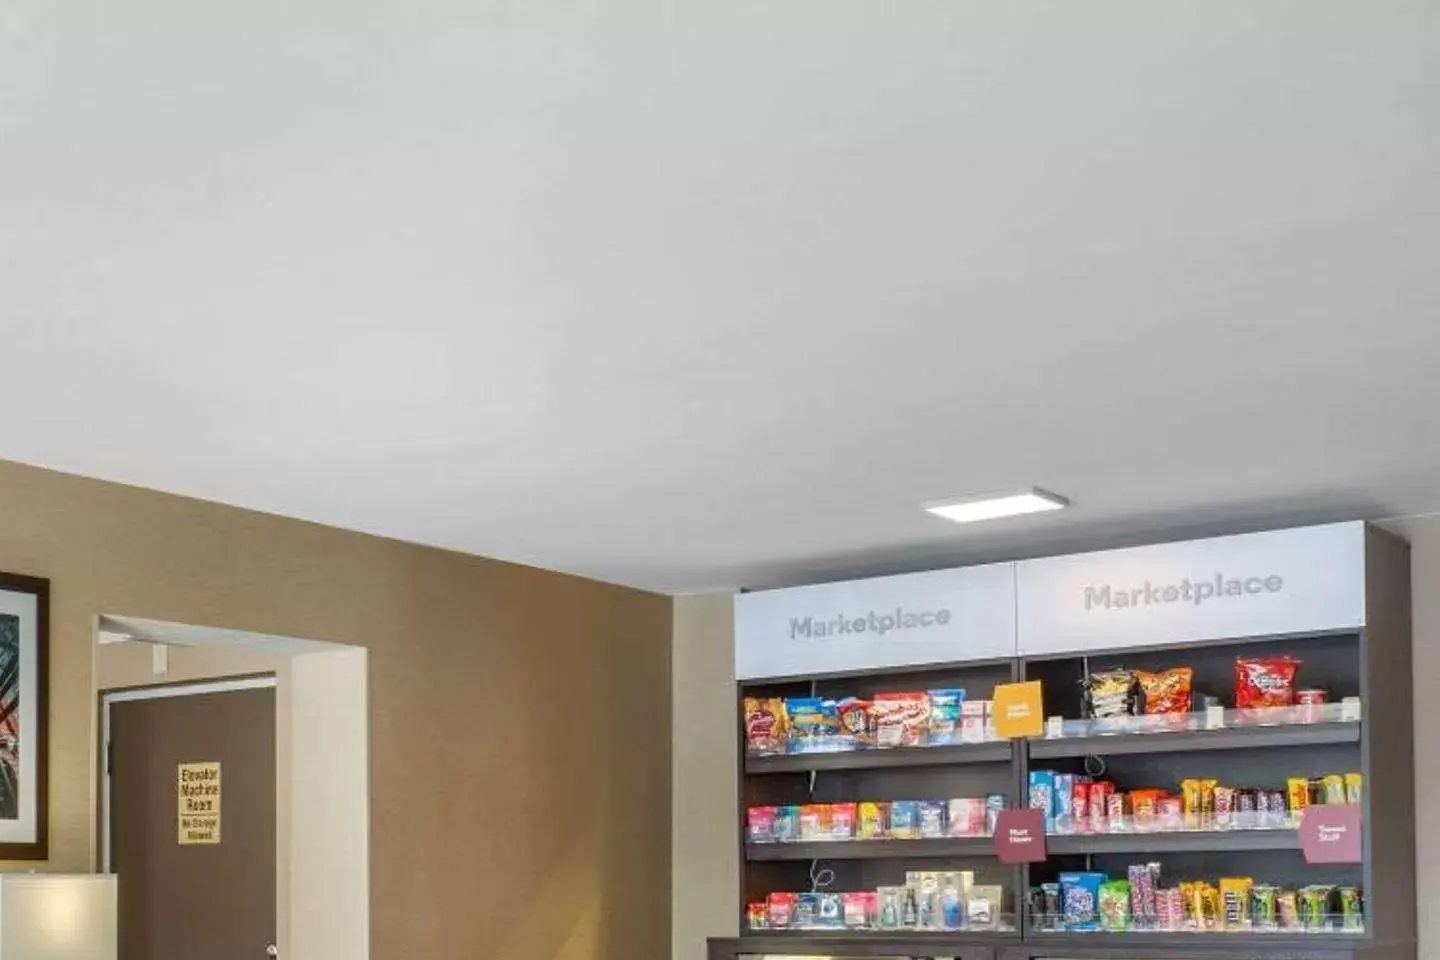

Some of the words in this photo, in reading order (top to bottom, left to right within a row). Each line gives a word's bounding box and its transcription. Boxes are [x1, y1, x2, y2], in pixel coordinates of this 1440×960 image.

[1083, 572, 1284, 611] Marketplace
[789, 606, 952, 640] Marketplace
[182, 768, 217, 782] Elevator
[181, 783, 218, 797] Machine
[187, 798, 212, 811] Room
